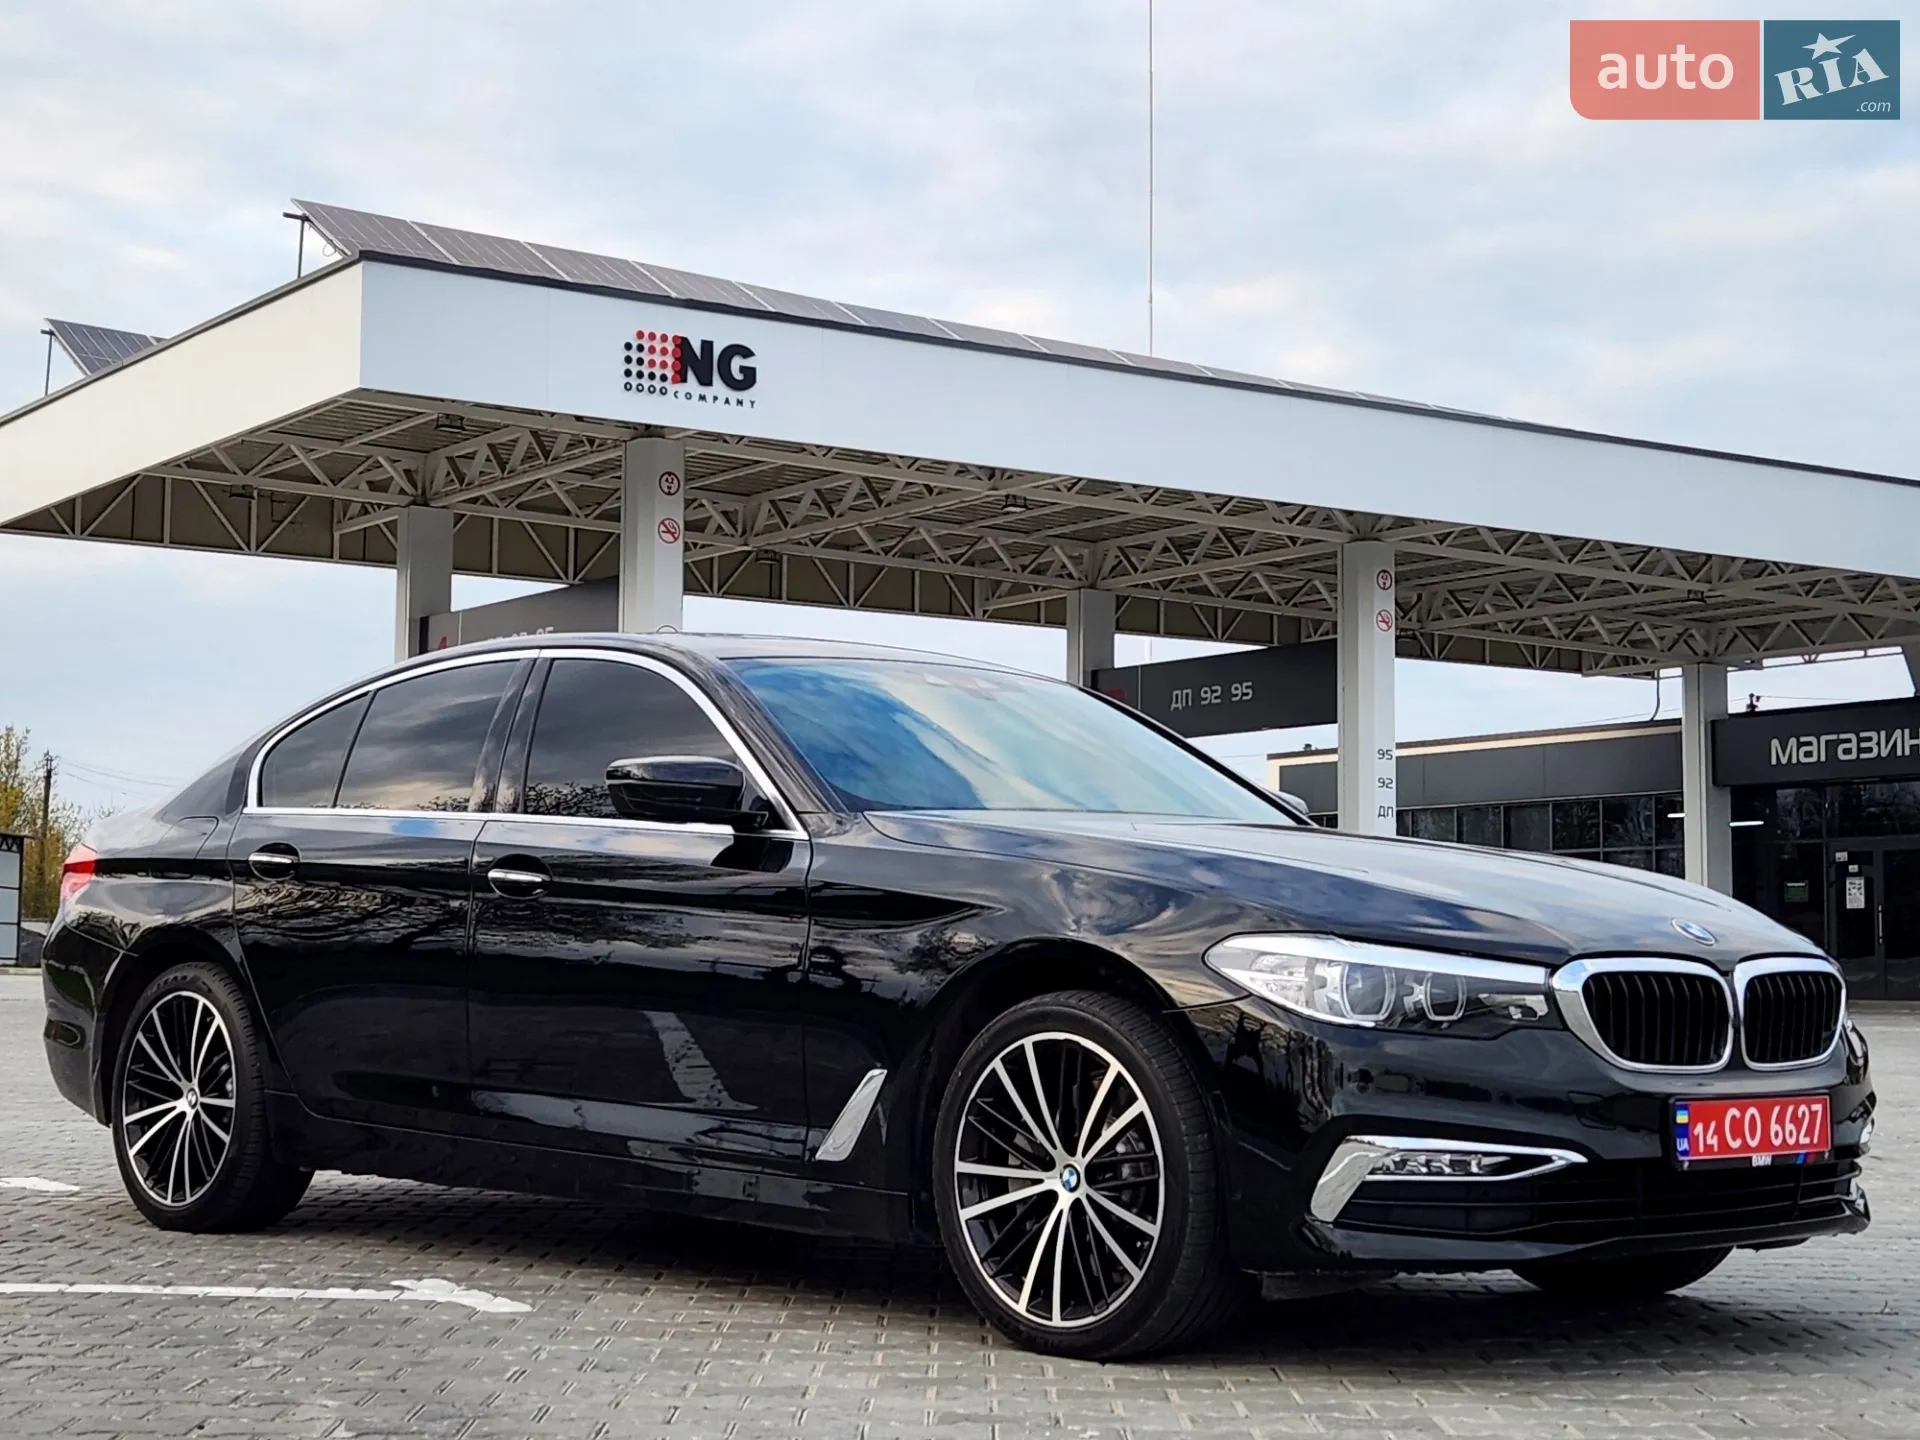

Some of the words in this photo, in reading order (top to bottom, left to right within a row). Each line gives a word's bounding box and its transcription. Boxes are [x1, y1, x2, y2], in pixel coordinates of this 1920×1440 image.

[673, 335, 757, 391] NG
[673, 390, 756, 408] COMPANY
[1170, 688, 1192, 711] ДП
[1200, 685, 1222, 705] 92
[1231, 681, 1253, 701] 95
[1377, 748, 1393, 760] 95
[1377, 777, 1393, 789] 92
[1377, 805, 1394, 818] ДП
[1693, 1121, 1718, 1153] 14
[1724, 1106, 1762, 1149] CO
[1769, 1103, 1823, 1147] 6627
[1676, 1137, 1689, 1151] UA
